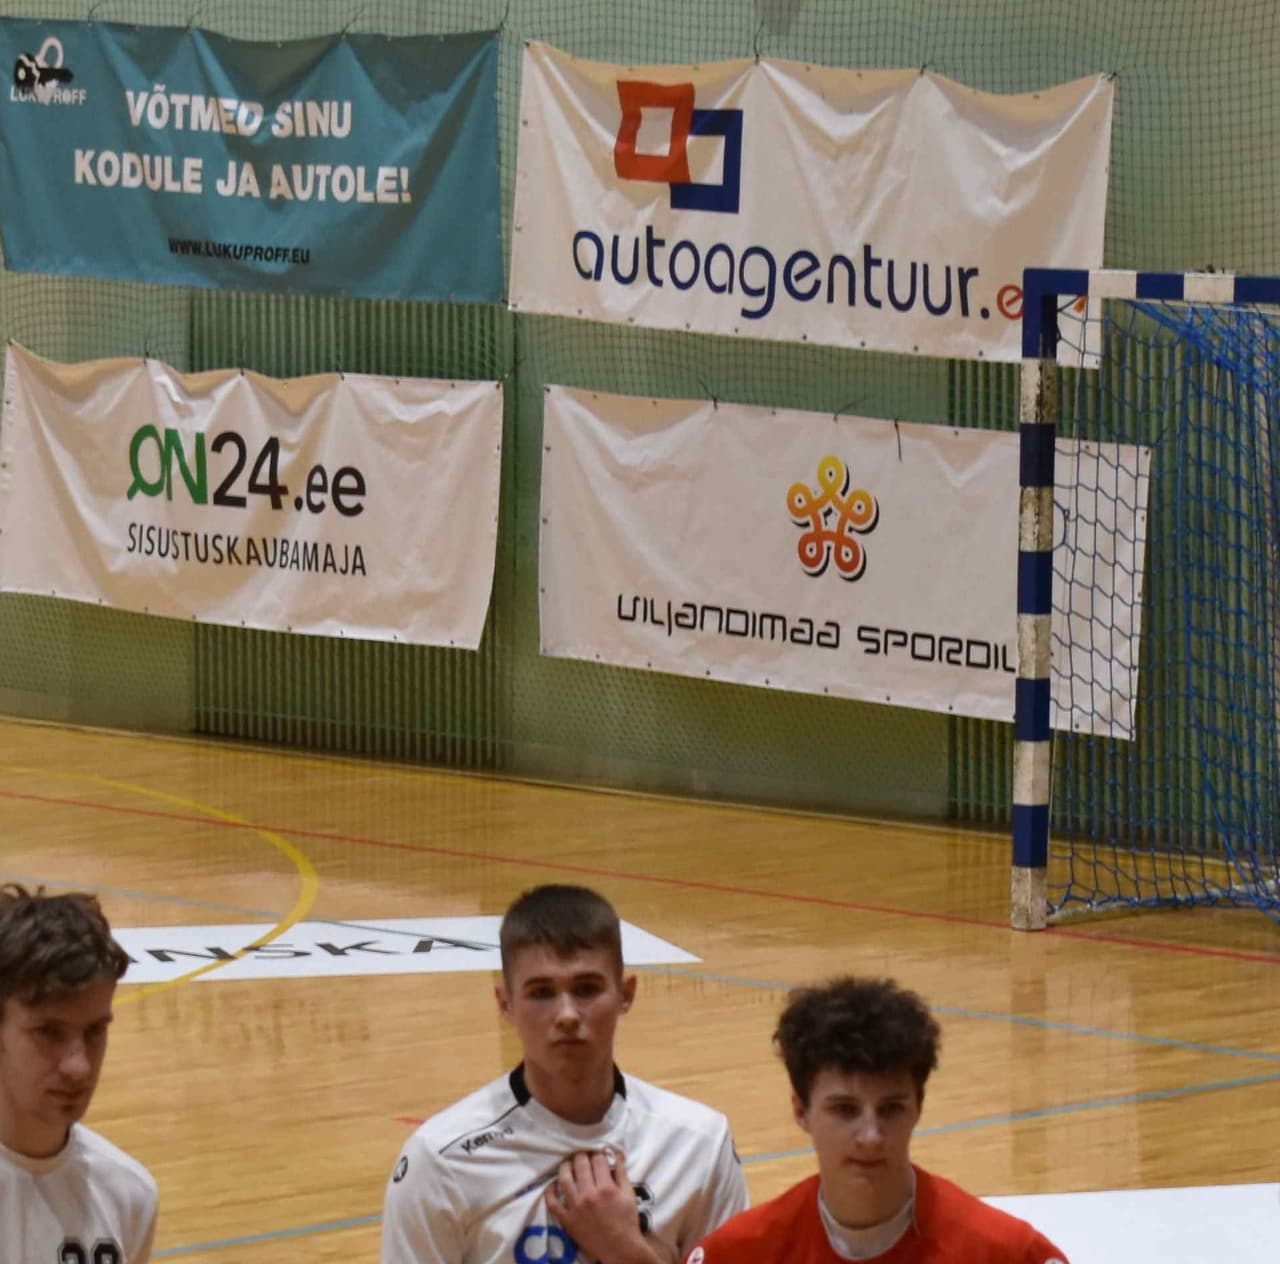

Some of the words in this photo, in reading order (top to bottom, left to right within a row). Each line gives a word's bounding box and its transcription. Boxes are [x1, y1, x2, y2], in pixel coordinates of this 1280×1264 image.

[126, 84, 264, 138] VÕTMED
[271, 100, 352, 138] SINU
[74, 148, 203, 195] KODULE
[216, 161, 261, 199] JA
[269, 165, 412, 204] AUTOLE!
[168, 237, 311, 265] WWW.LUKUPROFF.EU
[571, 225, 1026, 320] autoagentuur.e
[126, 423, 367, 518] ON24.ee
[126, 522, 367, 577] SISUSTUSKAUBAMAJA
[856, 625, 1016, 674] SPORDIL
